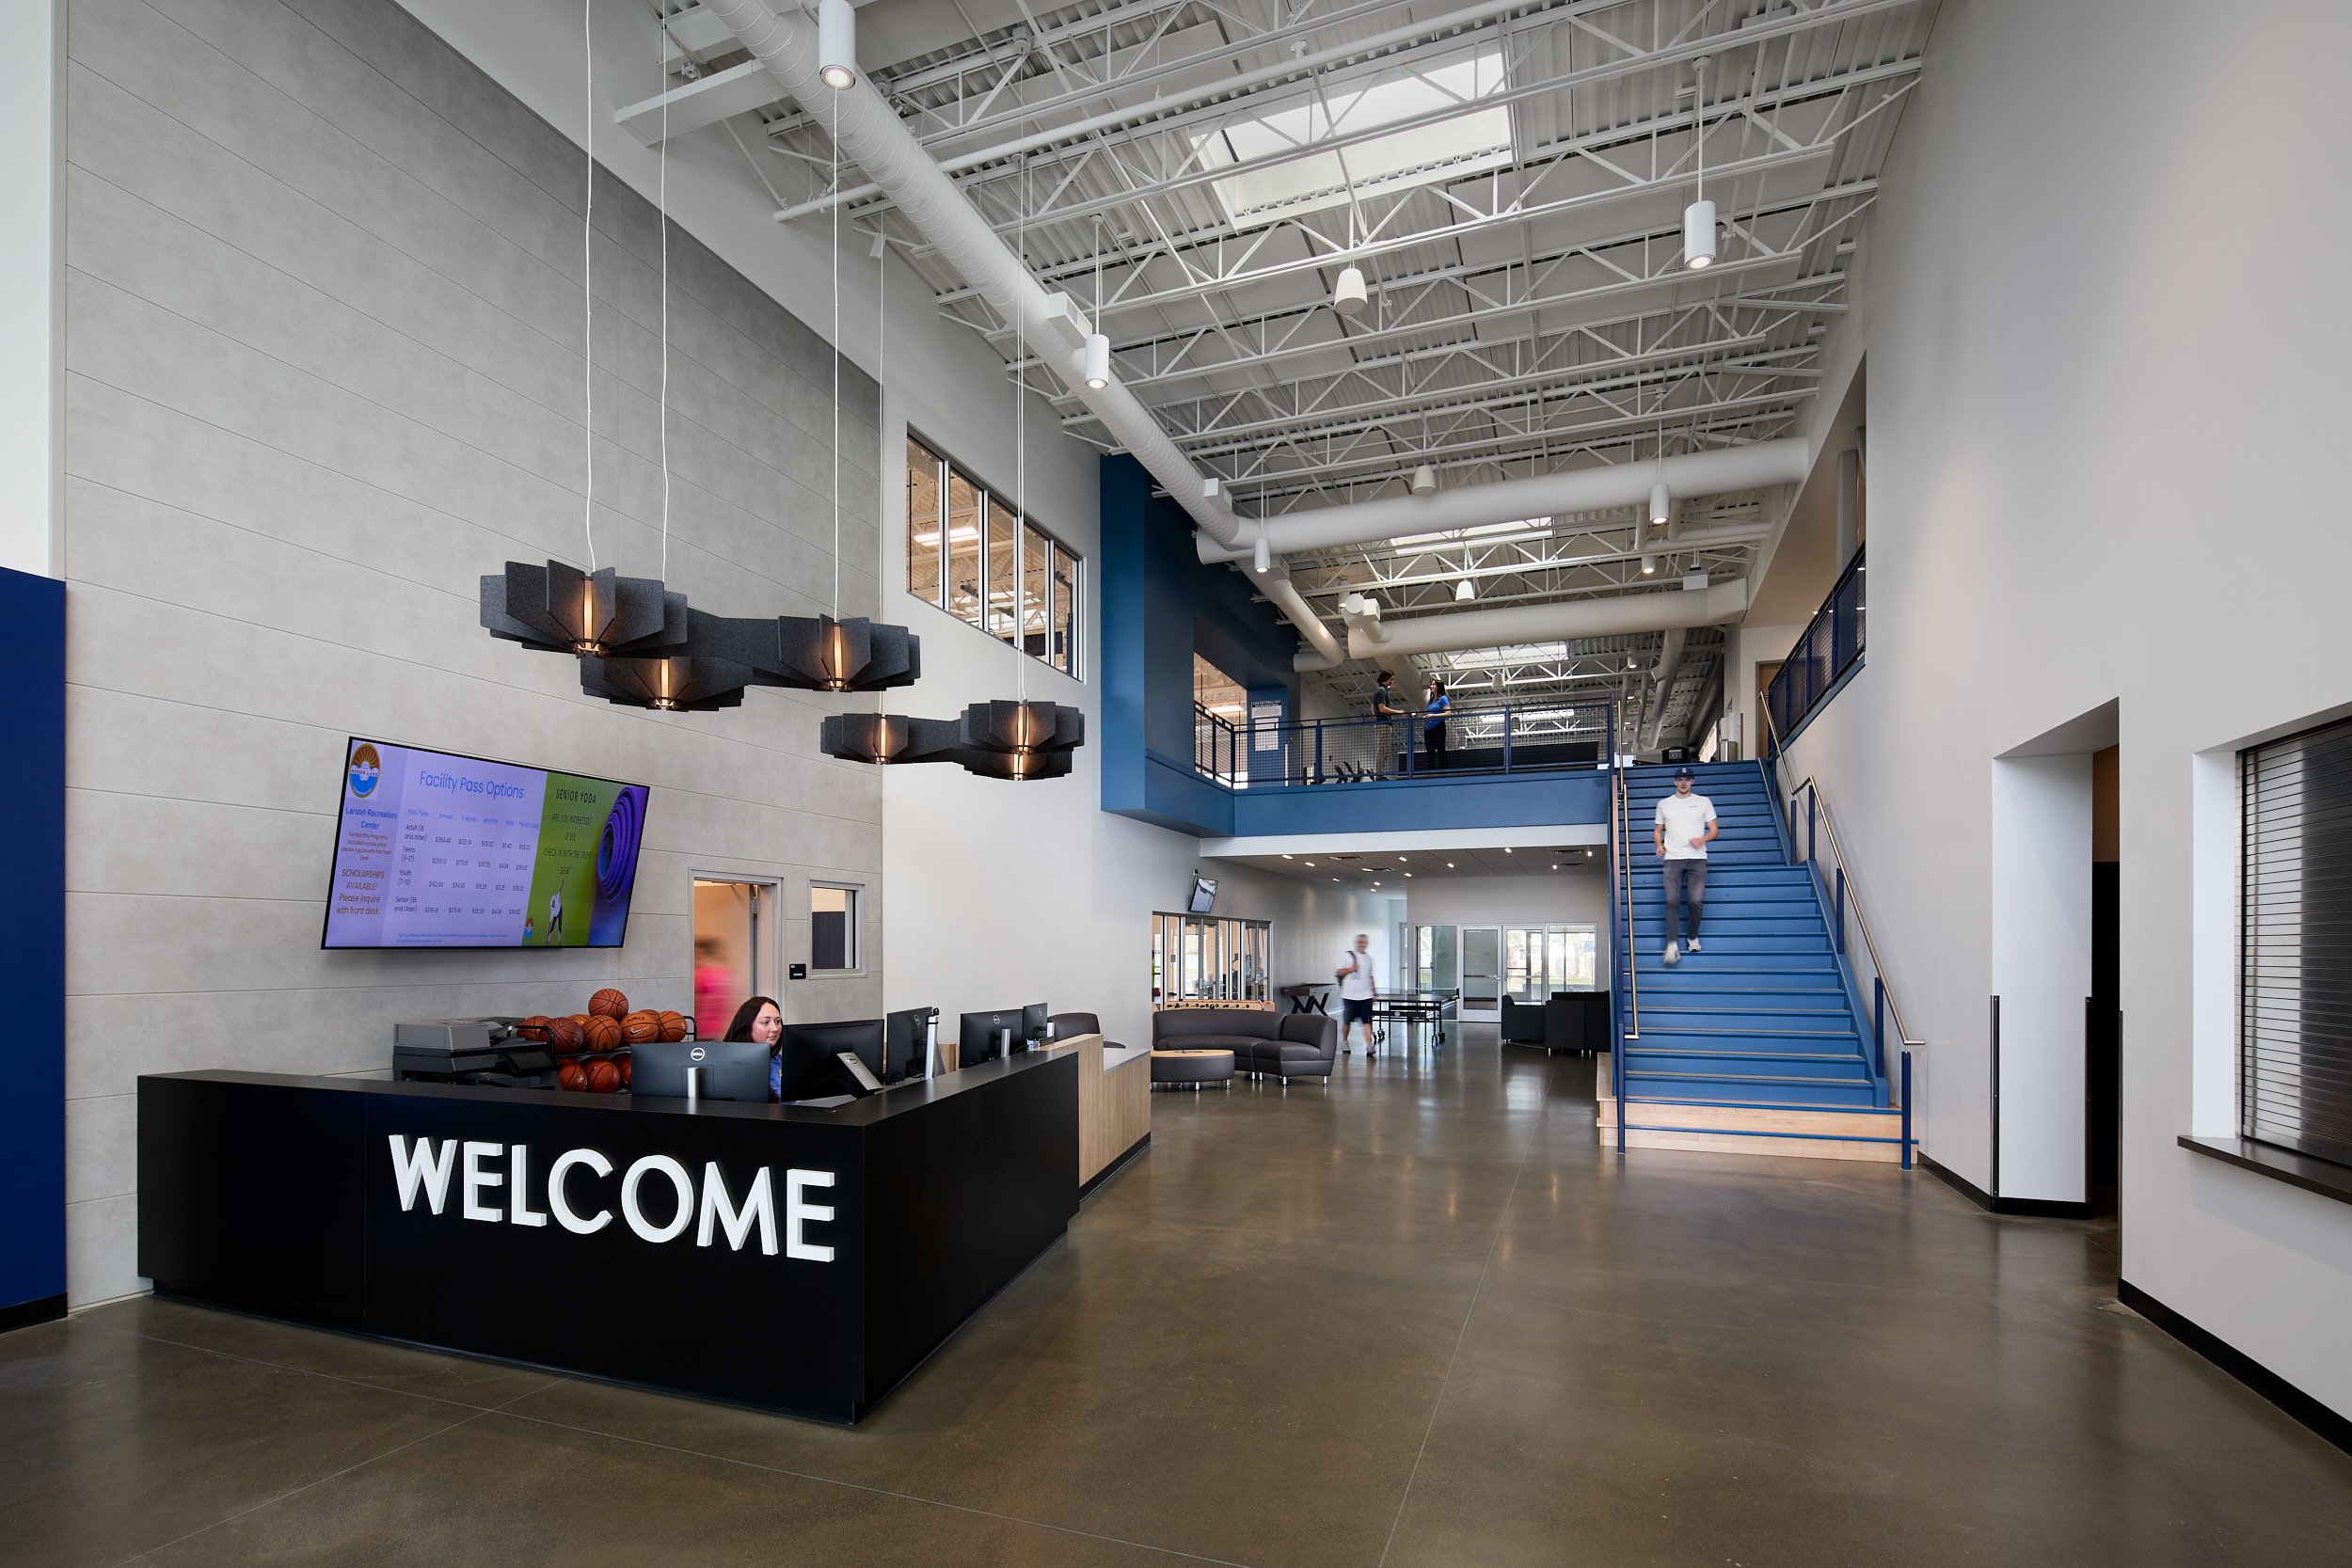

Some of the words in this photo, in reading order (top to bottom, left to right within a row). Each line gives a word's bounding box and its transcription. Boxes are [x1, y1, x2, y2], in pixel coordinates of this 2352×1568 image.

[420, 770, 458, 794] Facility
[459, 777, 485, 796] Pass
[485, 780, 525, 800] Options
[555, 788, 579, 801] SENIOR
[580, 792, 596, 804] YOGA
[345, 807, 366, 816] Larson
[367, 809, 398, 819] Recreation
[418, 809, 429, 817] Type
[483, 817, 499, 827] Monthly
[551, 813, 560, 822] ARE
[560, 814, 569, 823] YOU
[360, 820, 381, 830] Center
[414, 833, 427, 842] older)
[543, 847, 557, 857] CHECK
[564, 849, 573, 858] WITH
[580, 850, 594, 859] FRONT
[342, 868, 386, 879] SCHOLARSHIPS
[345, 881, 378, 891] AVAILABLE!
[340, 894, 359, 902] Please
[360, 895, 381, 905] inquire
[409, 895, 418, 904] (55
[336, 906, 349, 914] with
[404, 905, 418, 913] Older)
[388, 1134, 835, 1263] WELCOME
